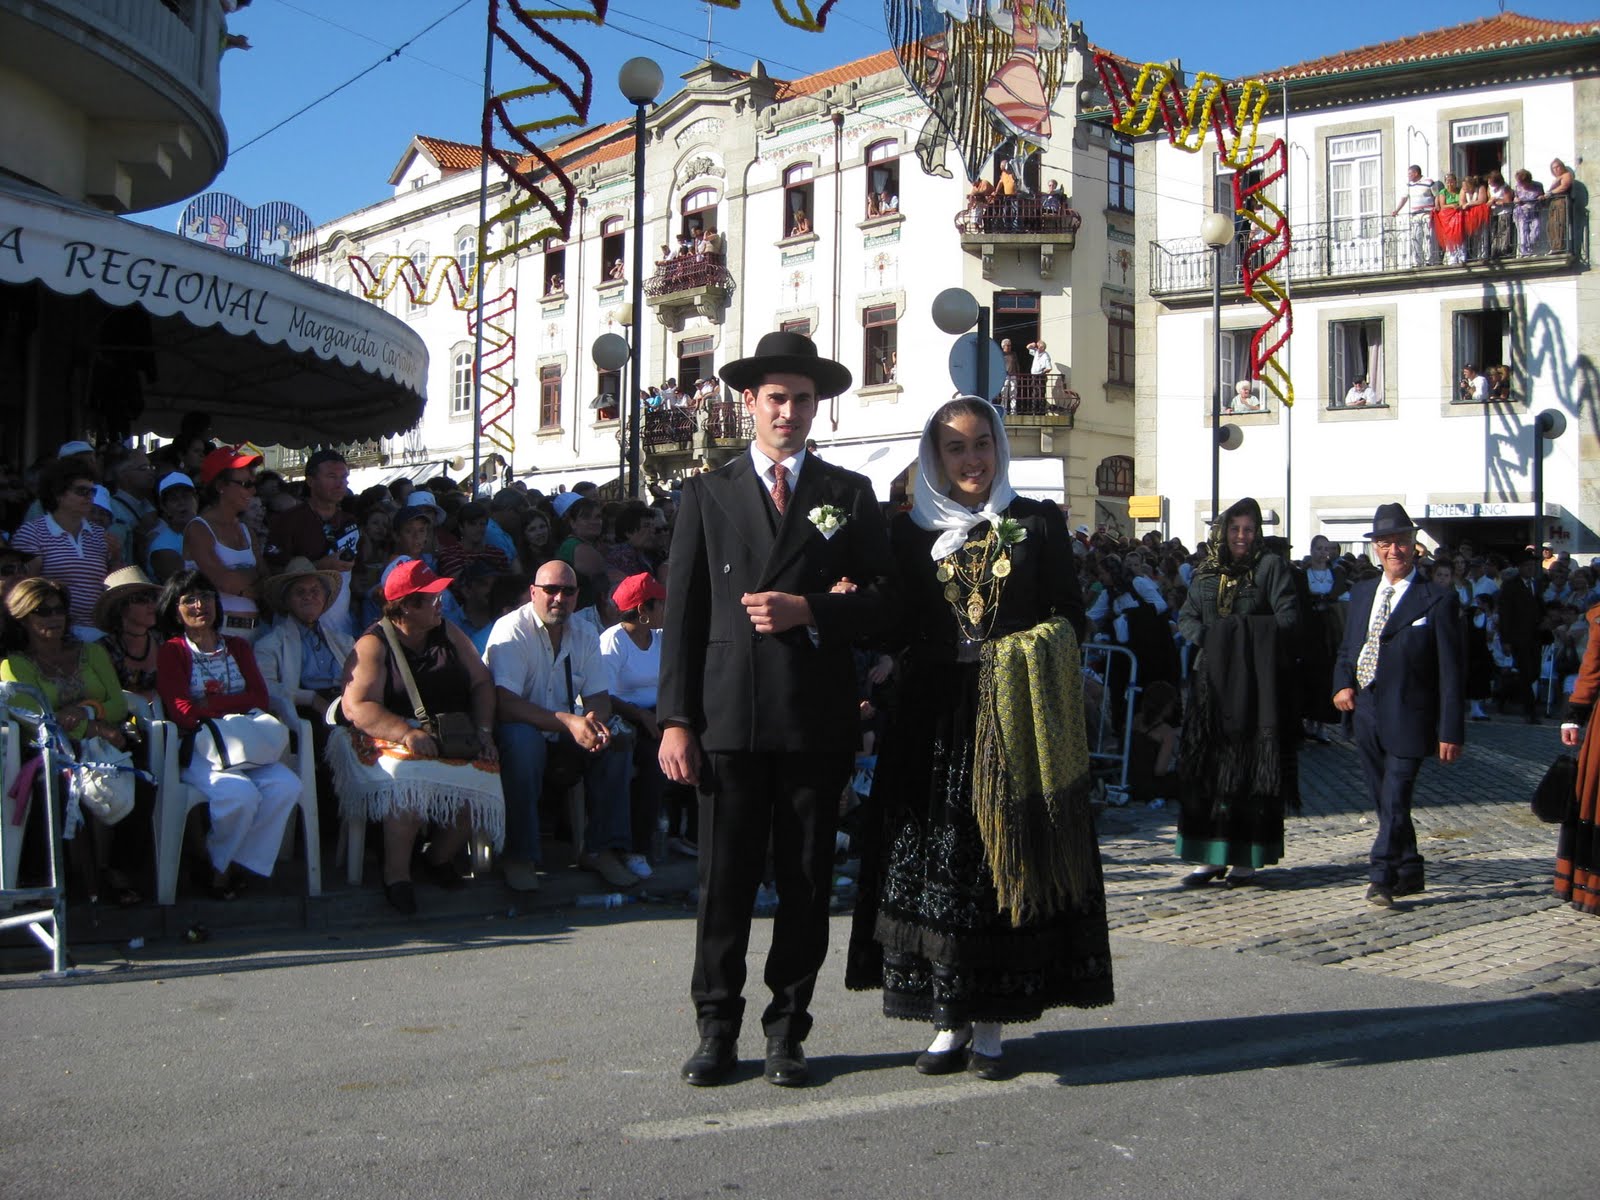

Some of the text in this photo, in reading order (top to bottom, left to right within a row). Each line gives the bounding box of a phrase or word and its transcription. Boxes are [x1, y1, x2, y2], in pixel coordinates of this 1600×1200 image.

[64, 241, 269, 326] REGIONAL
[288, 306, 379, 354] Margarida
[1428, 503, 1460, 516] HOTEL
